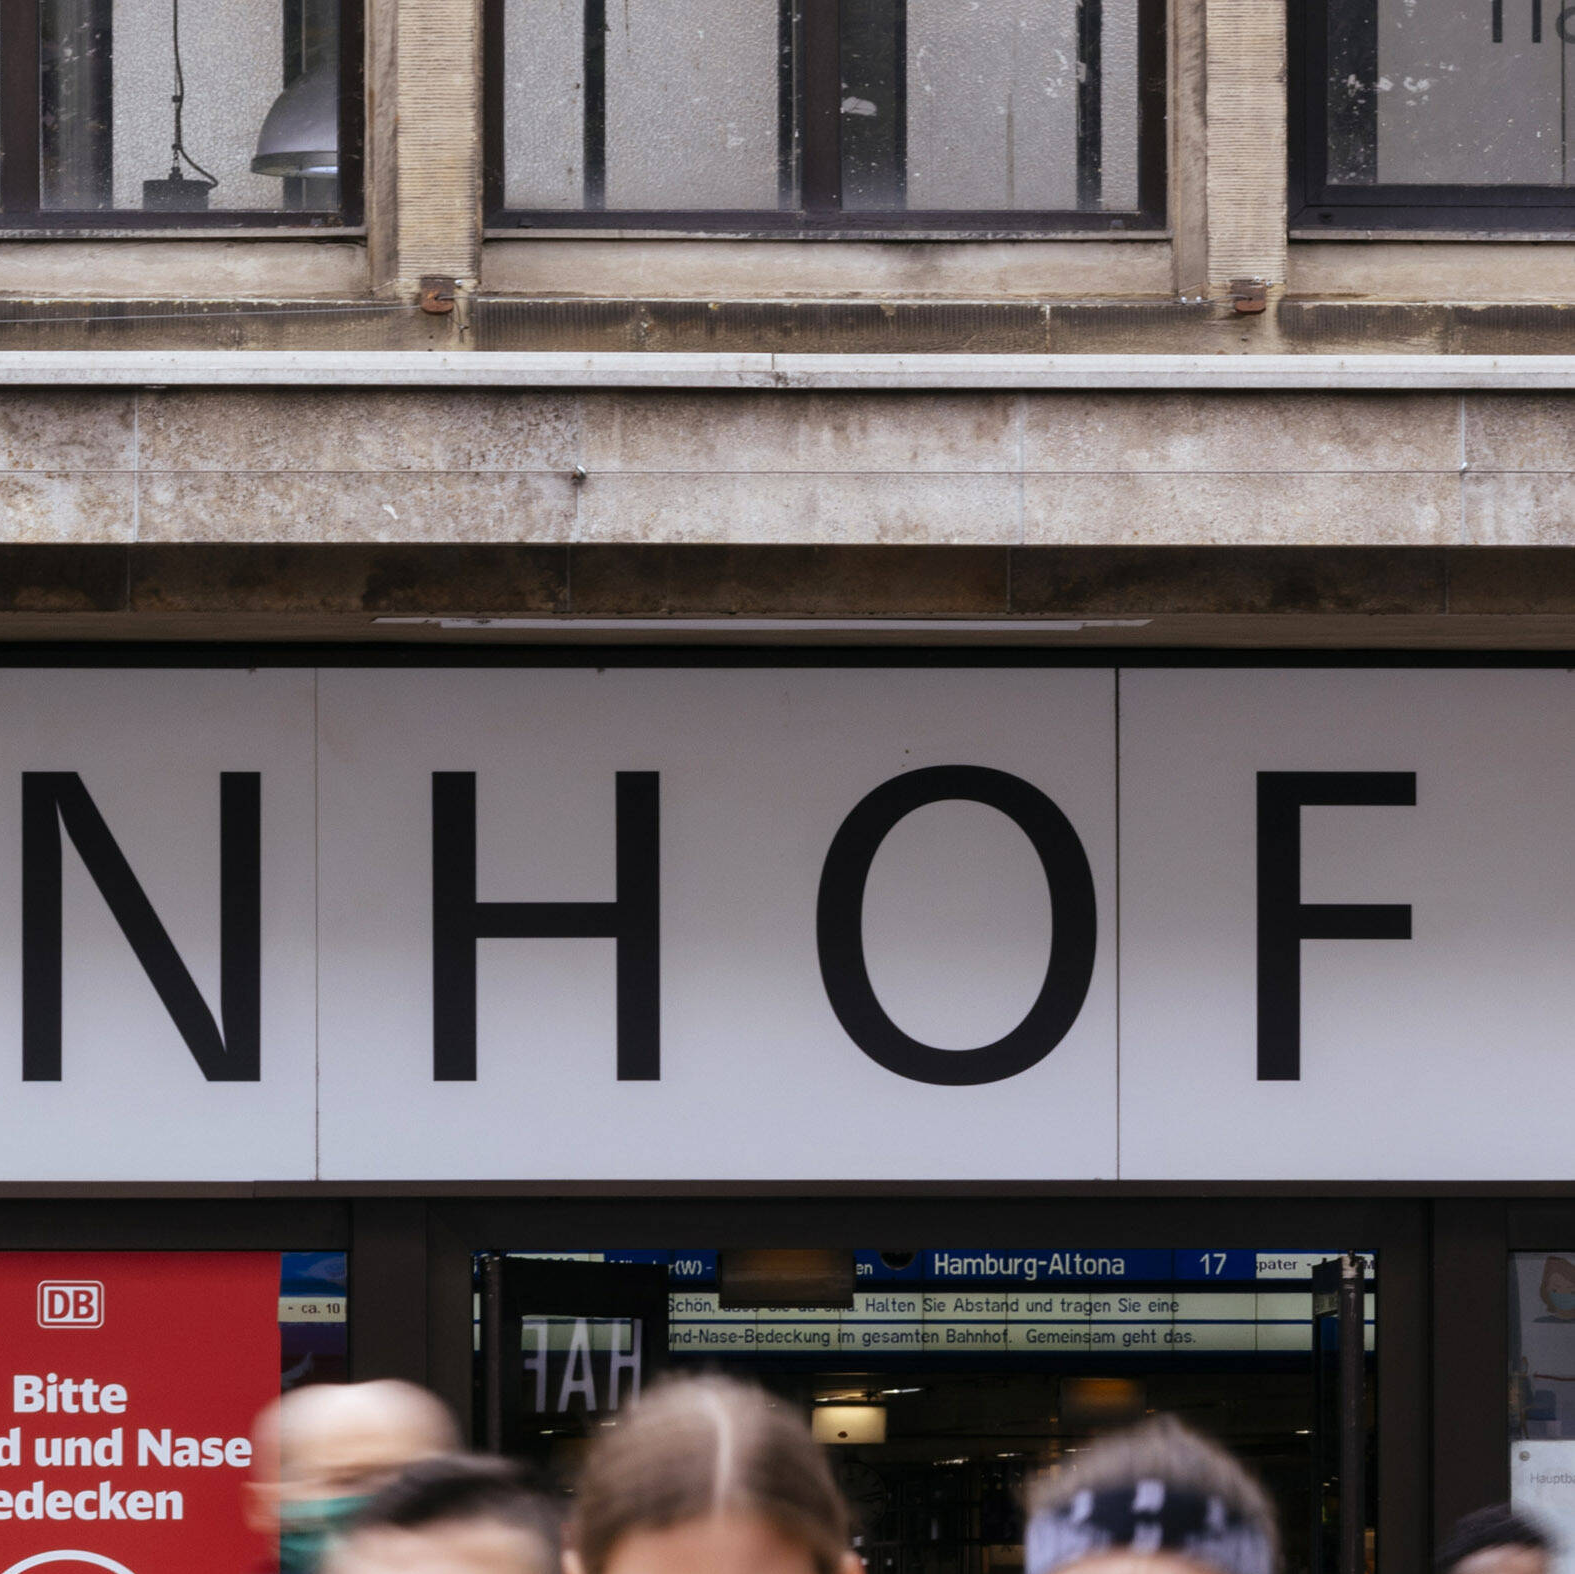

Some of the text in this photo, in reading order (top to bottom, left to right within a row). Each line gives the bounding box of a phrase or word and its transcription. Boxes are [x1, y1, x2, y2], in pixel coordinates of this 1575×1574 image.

[934, 1252, 1125, 1280] Hamburg-Altona
[1199, 1253, 1227, 1276] 17
[46, 1288, 96, 1321] DB
[865, 1297, 916, 1312] Halten
[923, 1297, 946, 1312] Sie
[954, 1297, 1019, 1312] Abstand
[1026, 1297, 1053, 1312] und
[1060, 1297, 1111, 1316] tragen
[1118, 1297, 1141, 1312] Sie
[1148, 1297, 1180, 1312] eine
[838, 1328, 856, 1344] im
[862, 1329, 940, 1347] gesamten
[947, 1328, 1013, 1344] Bahnhof.
[1026, 1328, 1116, 1344] Gemeinsam
[1122, 1328, 1157, 1348] geht
[1164, 1328, 1197, 1344] das.
[14, 1372, 128, 1414] Bitte
[35, 1426, 124, 1468] und
[138, 1428, 253, 1468] Nase
